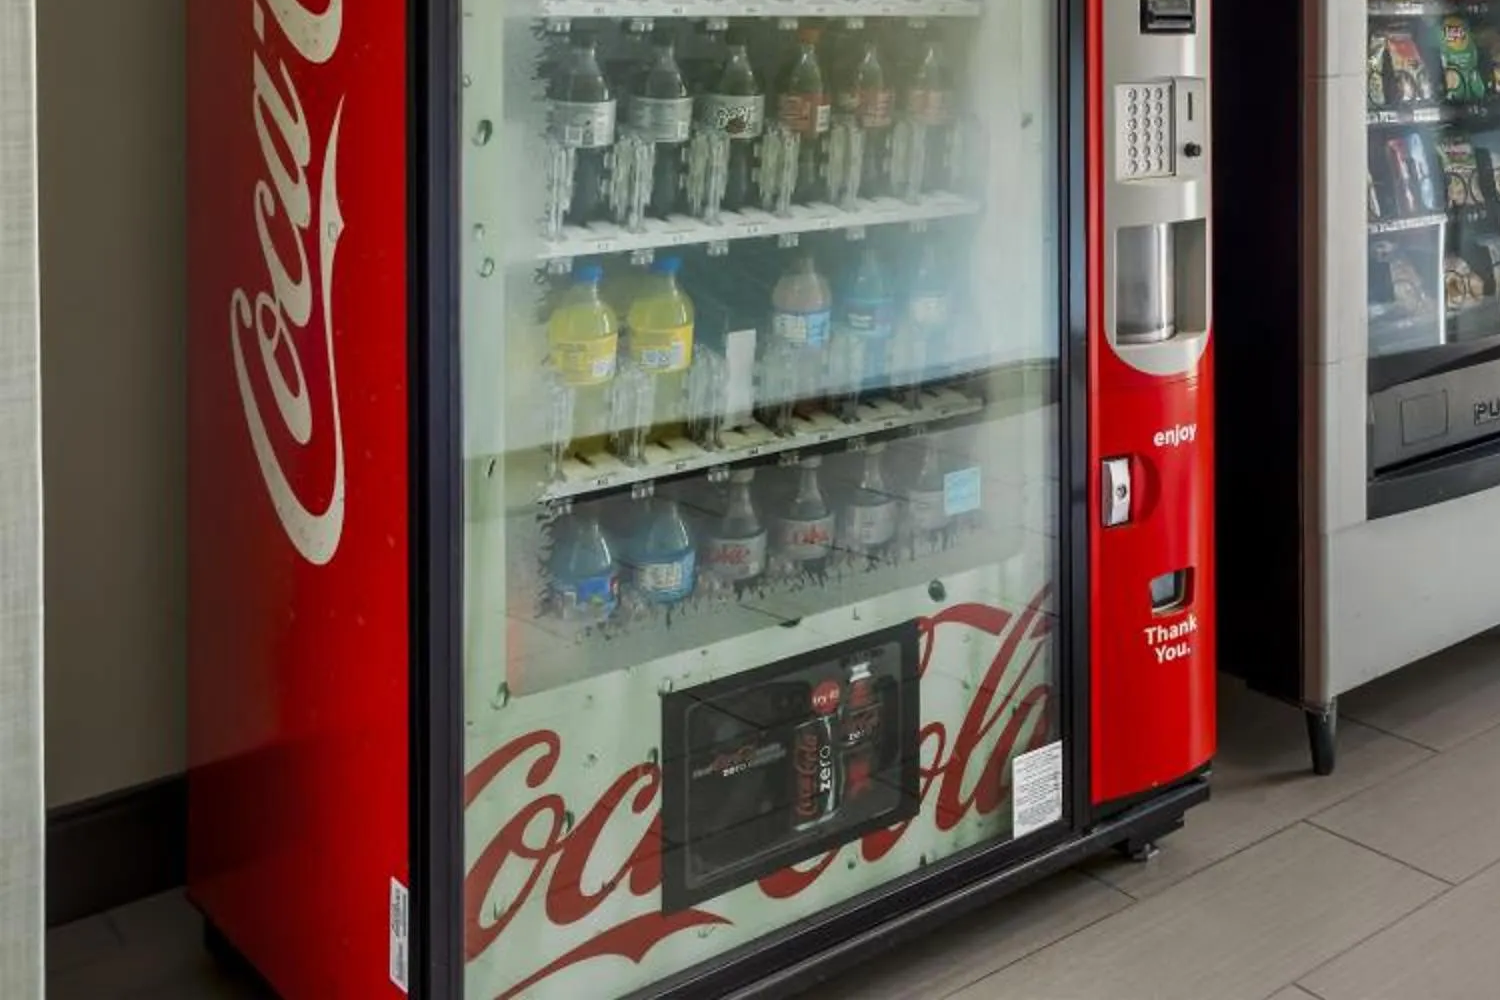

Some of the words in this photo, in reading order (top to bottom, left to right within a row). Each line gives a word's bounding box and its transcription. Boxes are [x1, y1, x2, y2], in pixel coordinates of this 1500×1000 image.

[1153, 423, 1197, 447] enjoy
[1144, 614, 1198, 645] Thank
[1155, 643, 1191, 664] You.
[819, 744, 832, 793] zero
